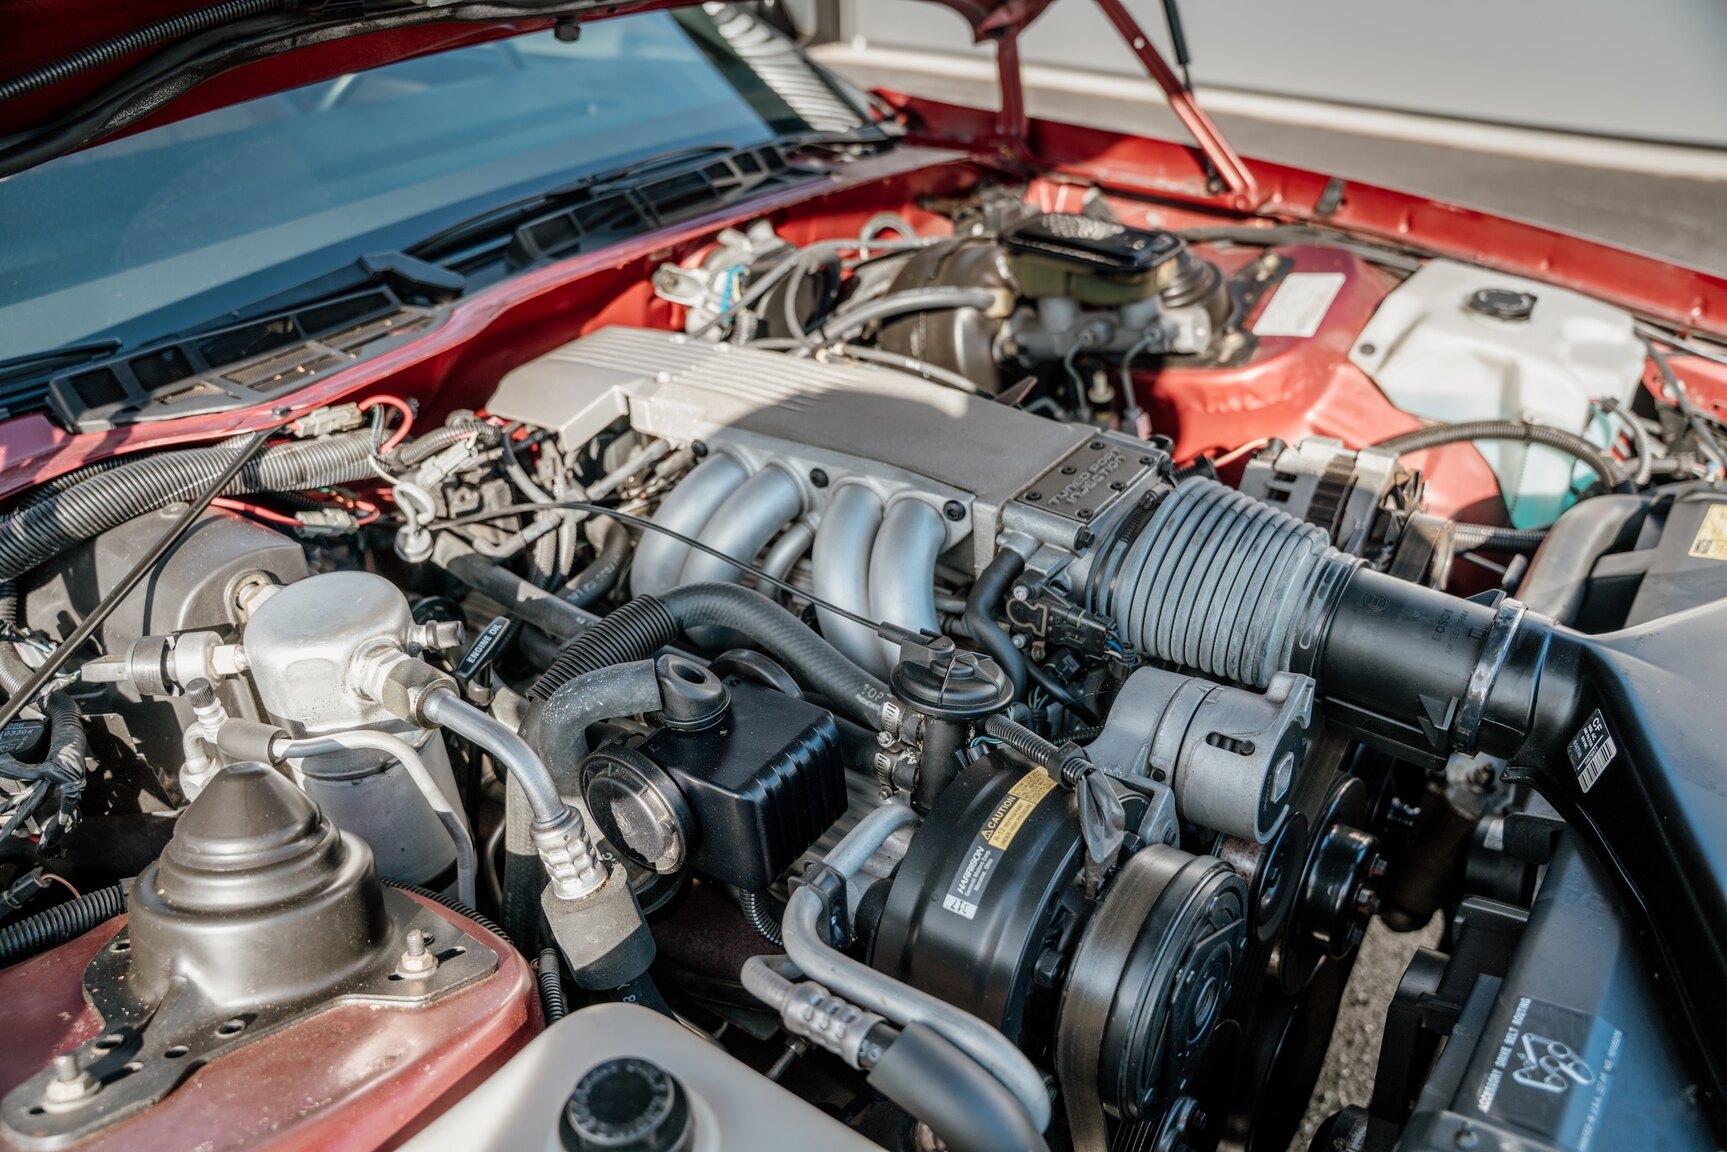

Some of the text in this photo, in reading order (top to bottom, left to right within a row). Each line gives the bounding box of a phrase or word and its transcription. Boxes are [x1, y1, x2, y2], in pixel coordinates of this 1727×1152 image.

[1049, 447, 1120, 504] TUNED PORT
[1066, 454, 1126, 504] INJECTION
[466, 624, 502, 664] ENGINE OIL
[1592, 717, 1603, 731] CF
[988, 795, 1016, 829] CAUTION
[956, 845, 985, 894] HARRISON
[964, 848, 992, 897] General Motors Corp.
[1477, 996, 1532, 1114] ACCESSORY DRIVE BELT ROUTING
